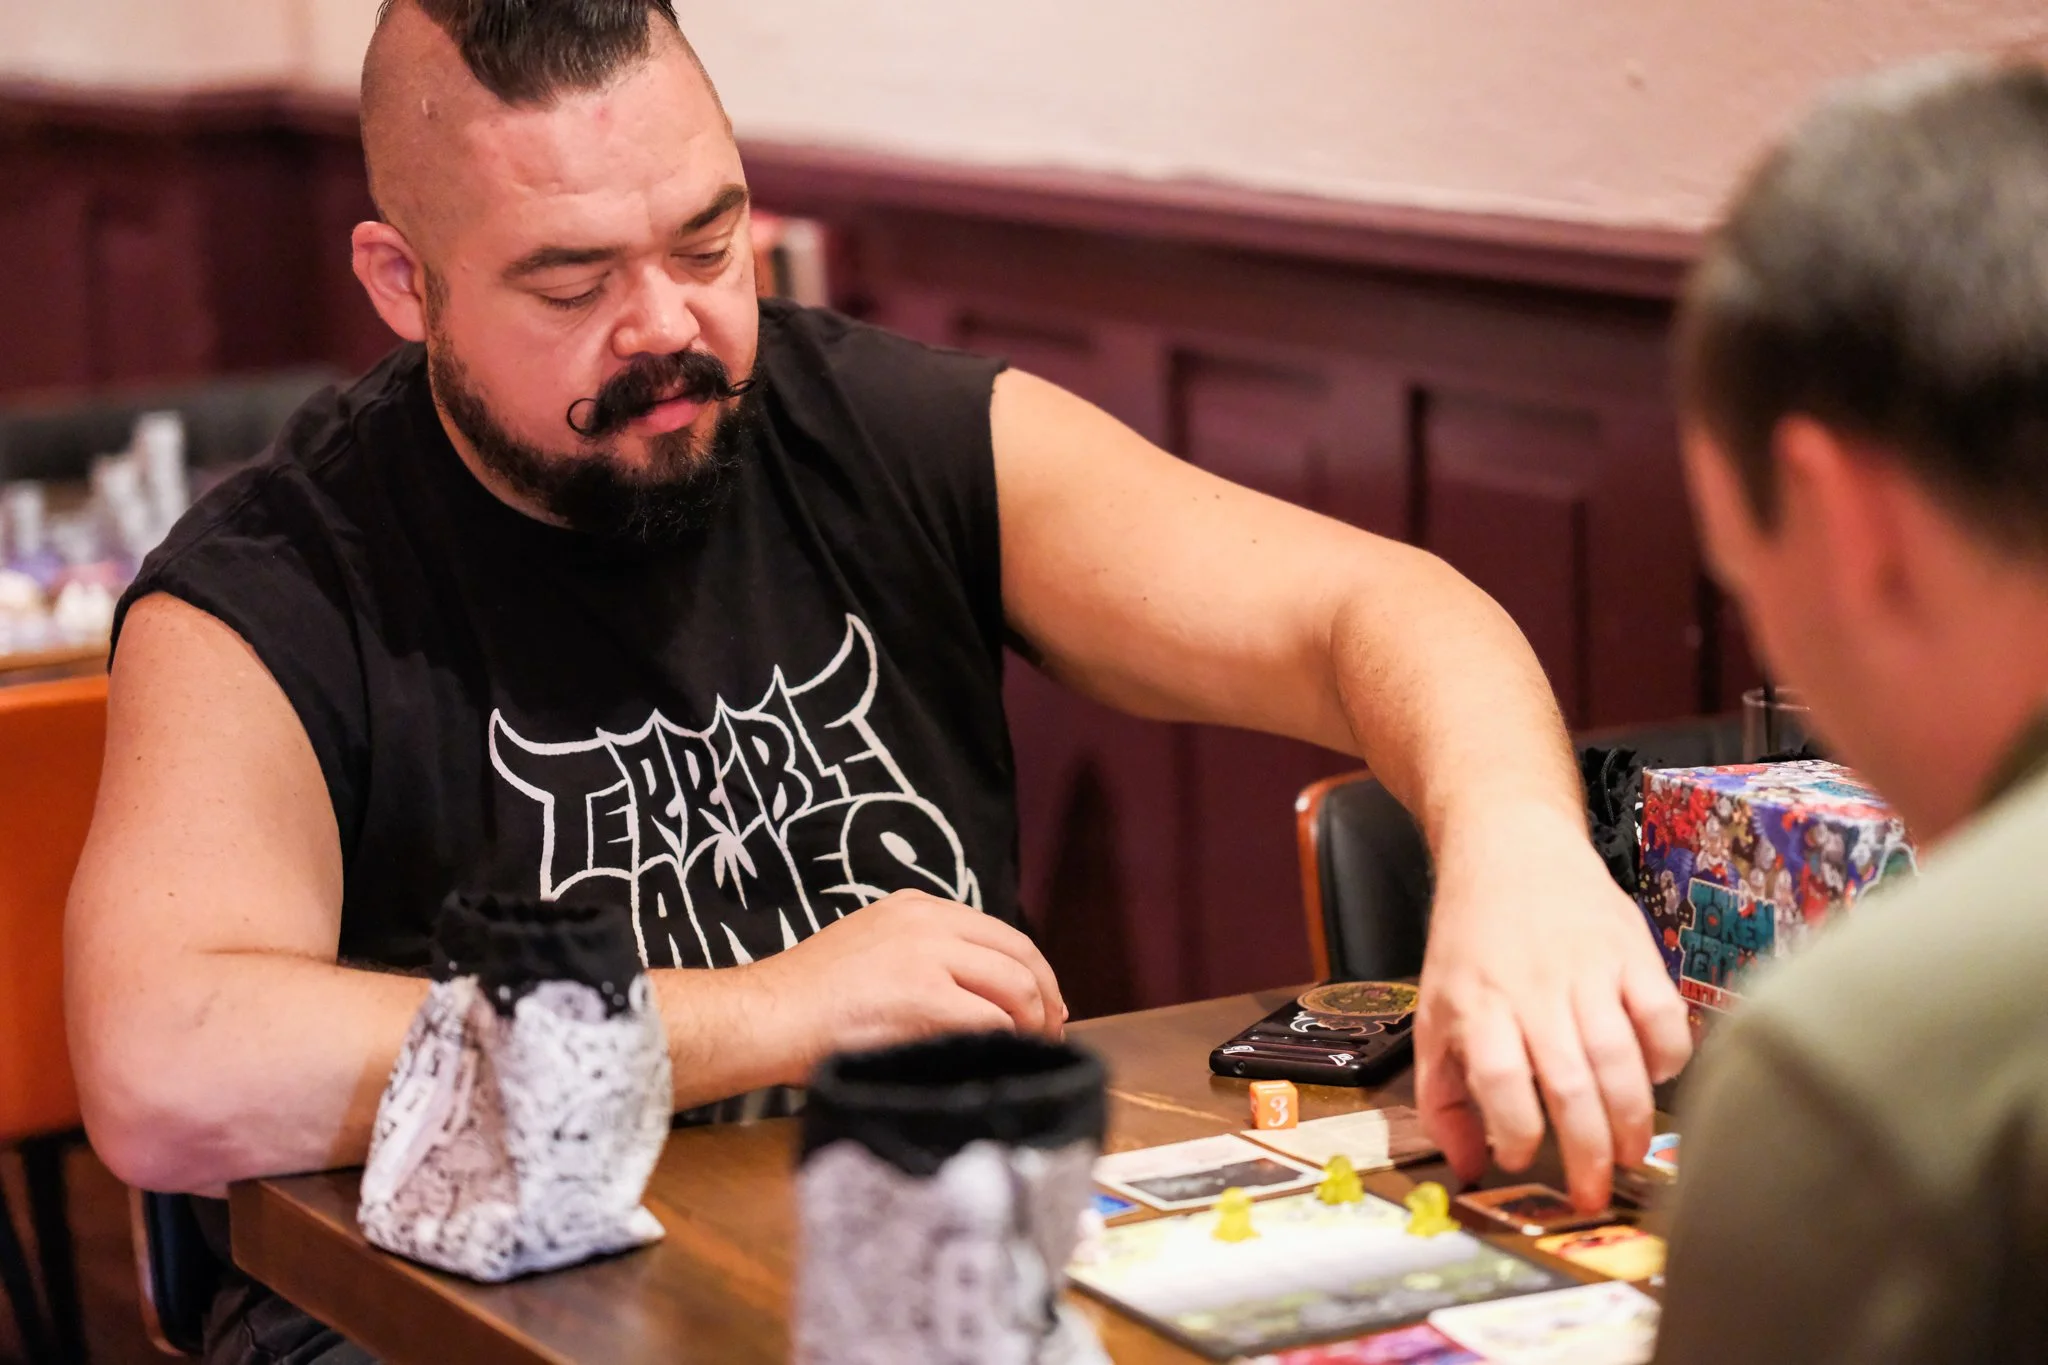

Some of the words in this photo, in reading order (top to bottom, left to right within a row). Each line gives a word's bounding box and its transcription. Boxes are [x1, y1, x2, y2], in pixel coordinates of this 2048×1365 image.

[489, 612, 917, 901] TERRIBLE
[552, 793, 983, 969] AMES
[1267, 1095, 1289, 1128] 3
